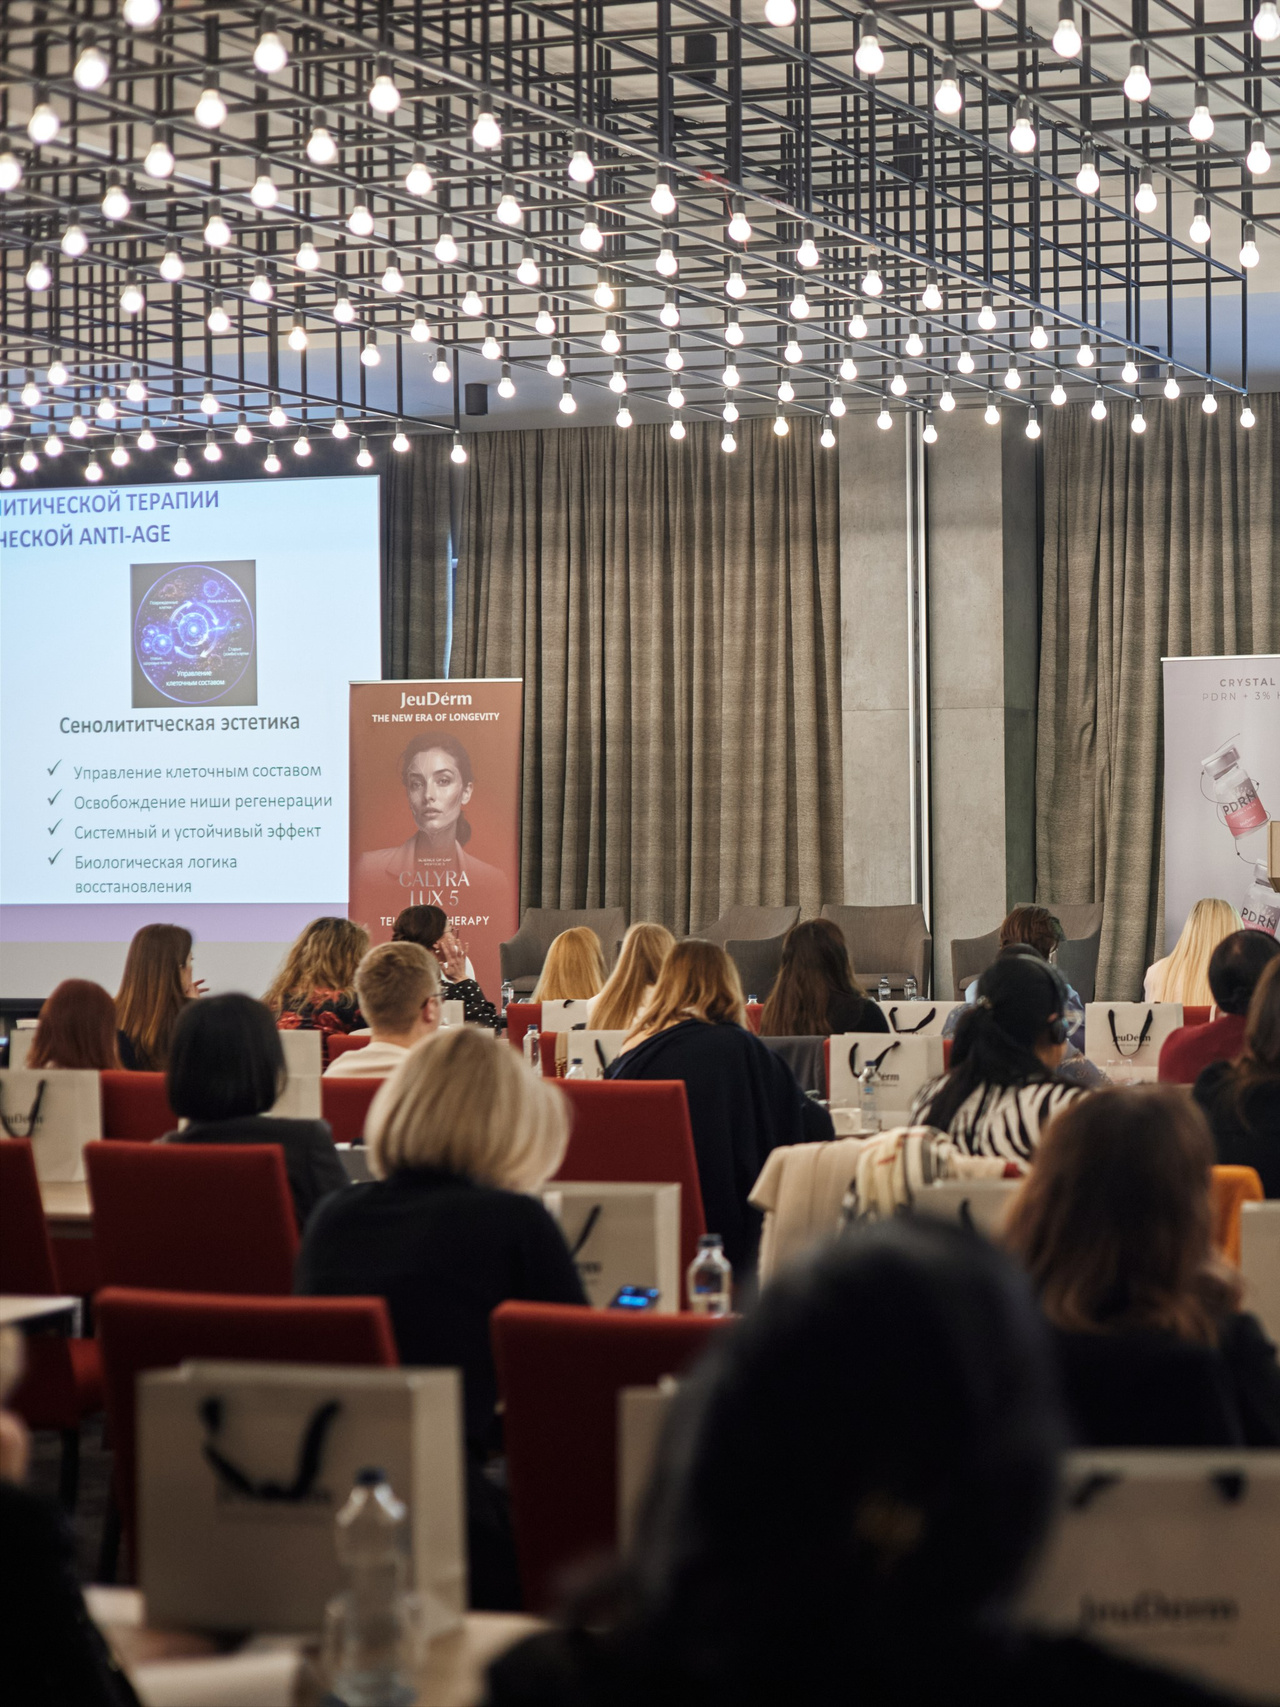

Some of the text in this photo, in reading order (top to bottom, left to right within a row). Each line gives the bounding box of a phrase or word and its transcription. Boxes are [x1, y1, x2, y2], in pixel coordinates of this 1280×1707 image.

[0, 490, 218, 515] ИТИЧЕСКОЙ ТЕРАПИИ
[79, 525, 170, 545] ANTI-AGE
[1219, 677, 1276, 687] CRYSTAL
[400, 692, 472, 708] JeuDérm
[1202, 692, 1236, 701] PDRN
[1255, 691, 1271, 700] 3%
[60, 716, 299, 733] Сенолититческая эстетика
[372, 714, 389, 722] THE
[392, 714, 413, 722] NEW
[435, 713, 447, 721] OF
[449, 713, 499, 721] LONGEVITY
[74, 766, 321, 782] Управление клеточным составом
[74, 795, 332, 811] Освобождение ниши регенерации
[1223, 791, 1256, 815] PDRN
[75, 823, 321, 841] Системный и устойчивый эффект
[76, 856, 237, 869] Биологическая логика
[399, 870, 470, 888] CALYRA
[76, 883, 191, 893] восстановления
[411, 890, 459, 906] LUX 5
[446, 916, 489, 925] HERAPY
[1241, 907, 1277, 929] PDRN
